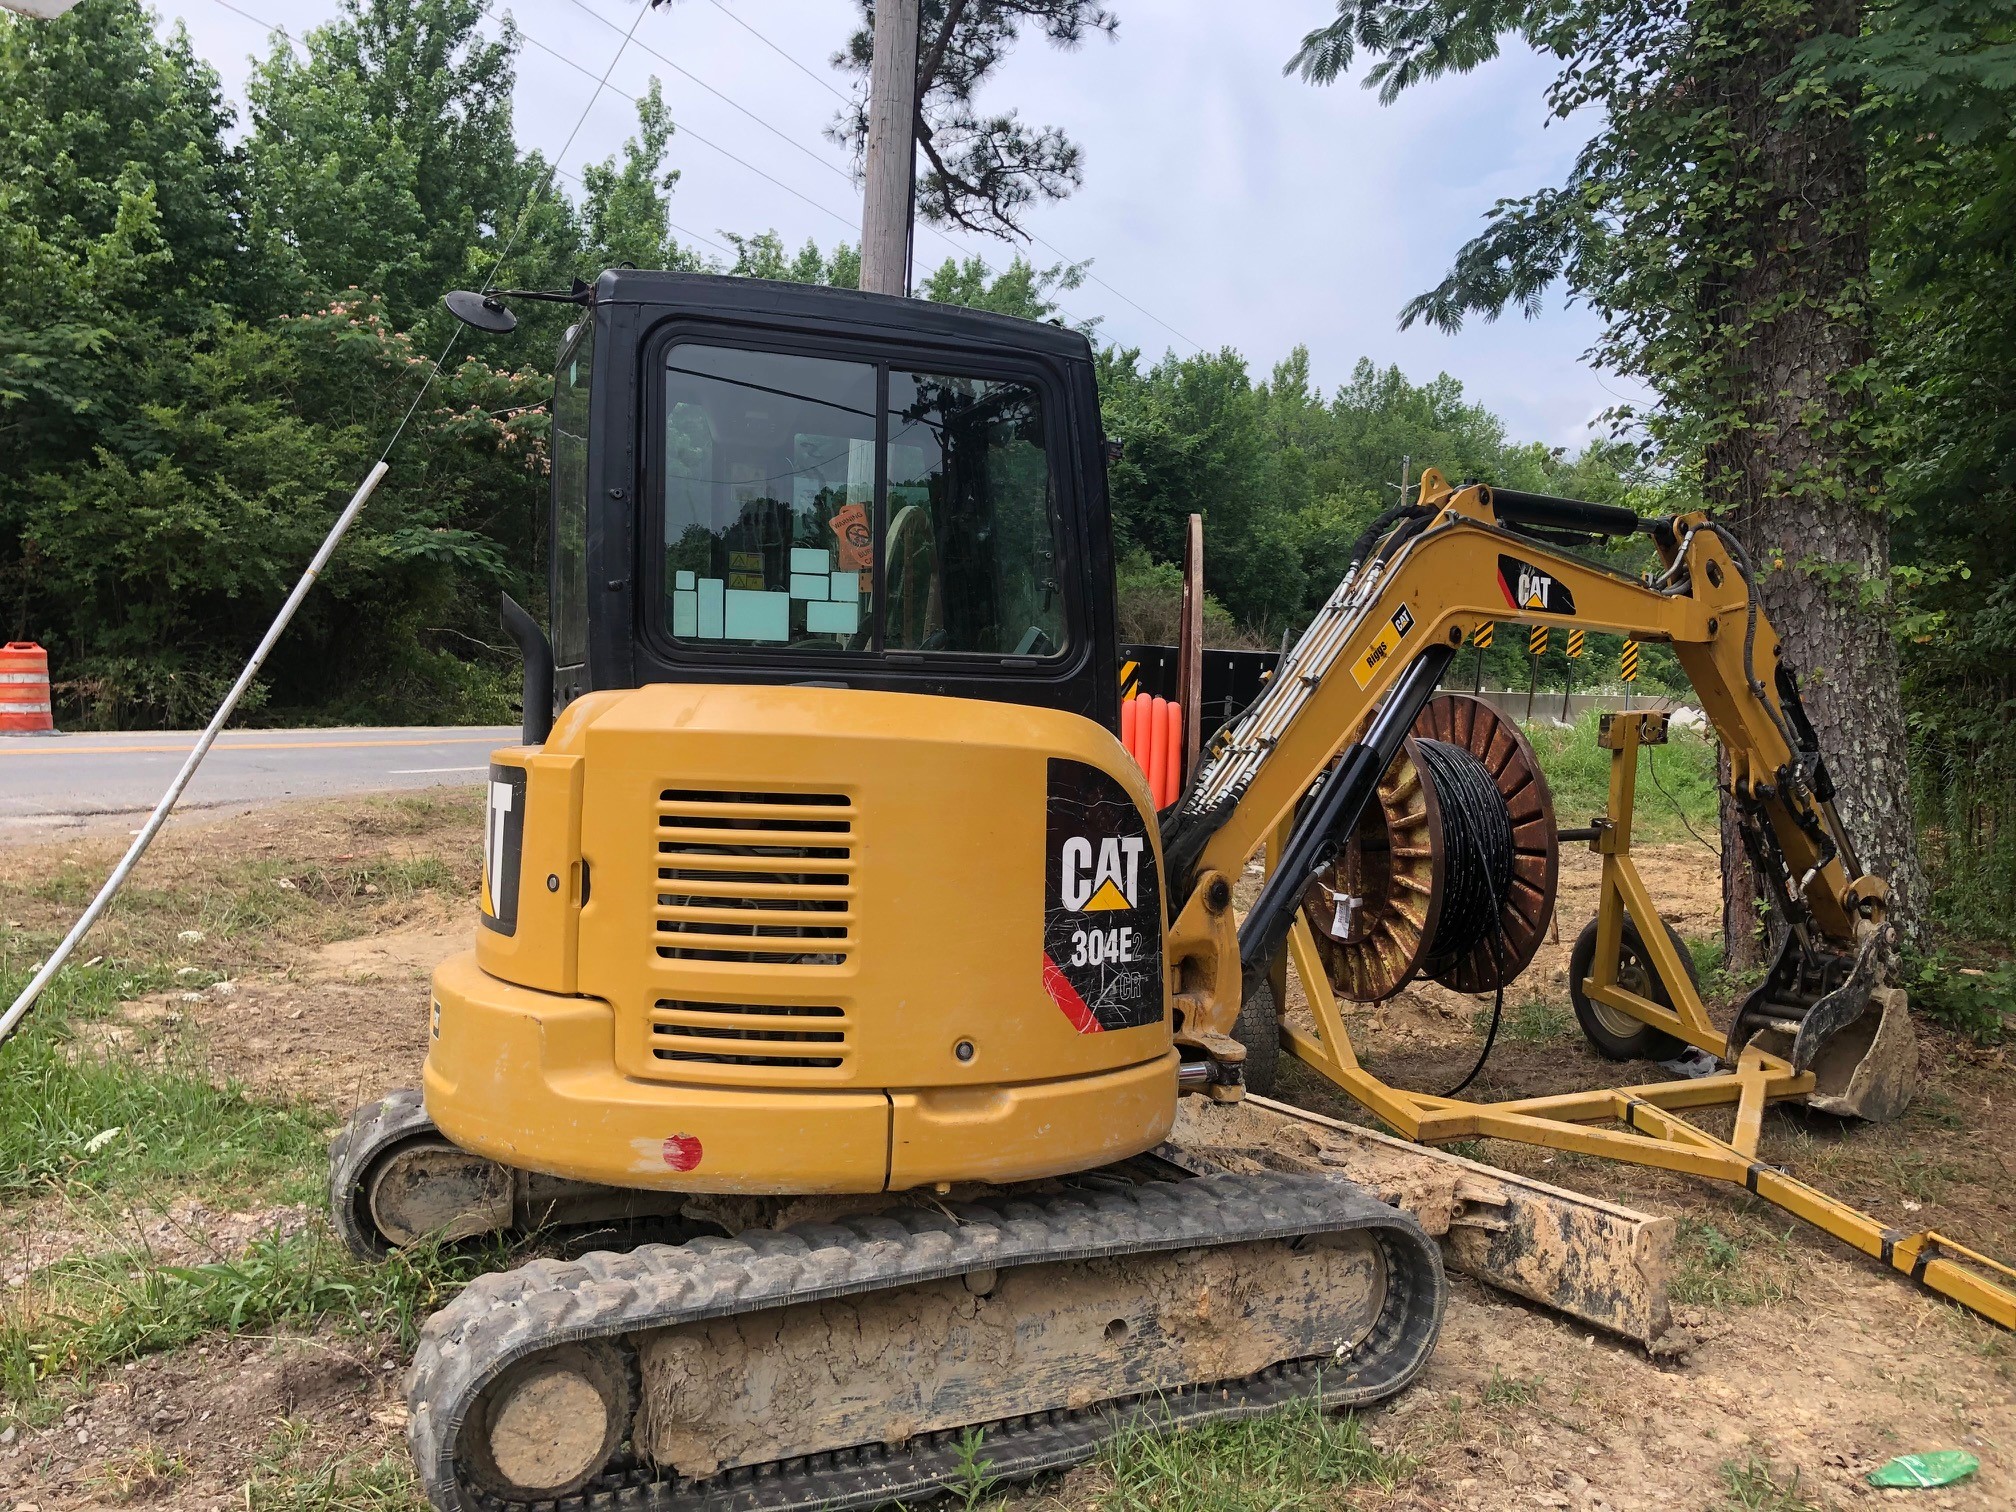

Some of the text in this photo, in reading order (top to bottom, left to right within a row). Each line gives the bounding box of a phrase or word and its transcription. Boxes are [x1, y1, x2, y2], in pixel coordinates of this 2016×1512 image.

[833, 511, 863, 529] WARNING
[1518, 574, 1551, 609] CAT
[1366, 610, 1411, 669] Riggs CAT
[1061, 836, 1144, 912] CAT
[1120, 972, 1141, 1000] CR
